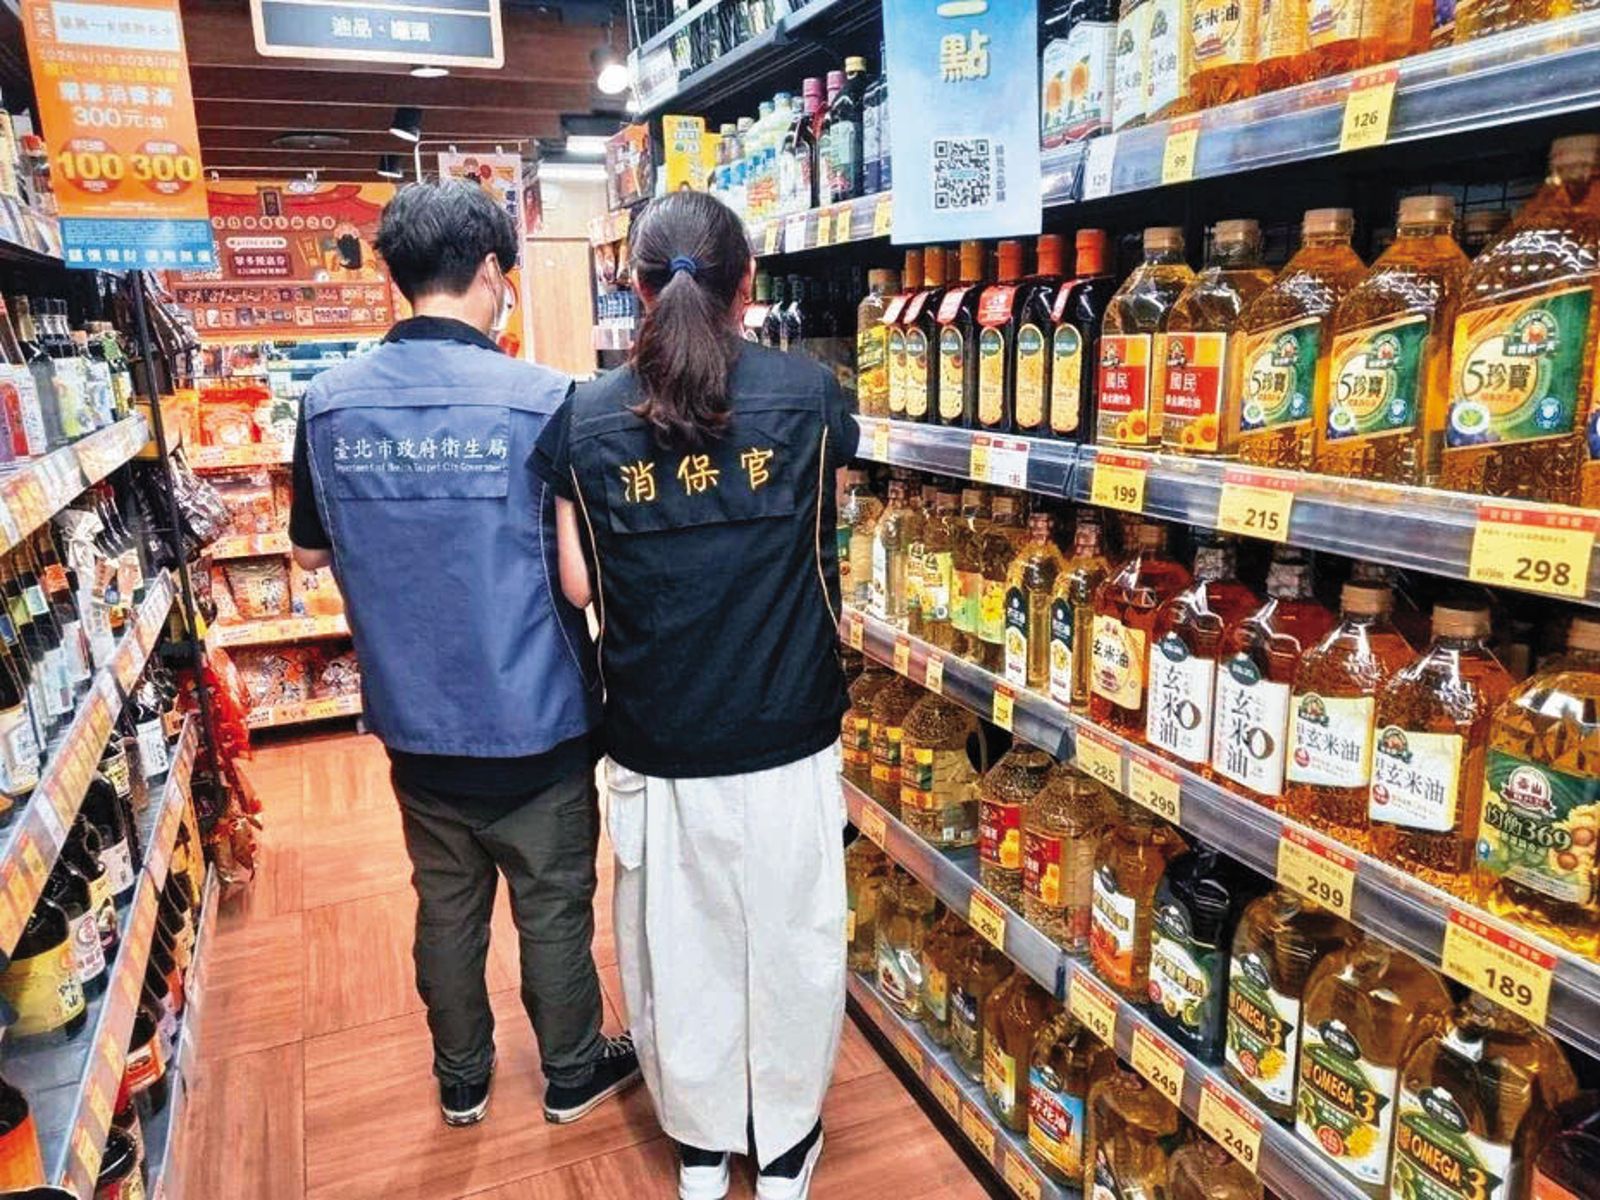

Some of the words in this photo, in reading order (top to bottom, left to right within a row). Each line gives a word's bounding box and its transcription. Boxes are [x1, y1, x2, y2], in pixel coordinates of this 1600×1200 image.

[1353, 111, 1378, 128] 126
[57, 152, 125, 180] 100
[130, 154, 199, 182] 300
[1105, 372, 1130, 391] 國民
[1169, 372, 1197, 392] 國民
[1337, 373, 1384, 402] 5珍寶
[1465, 360, 1532, 399] 5珍寶
[333, 437, 508, 461] 臺北市政府衛生局
[620, 448, 774, 503] 消保官
[1113, 486, 1138, 503] 199
[1244, 509, 1279, 531] 215
[1514, 557, 1571, 586] 298
[1094, 638, 1130, 670] 玄米油
[1160, 664, 1182, 748] 玄米油
[1227, 688, 1252, 779] 玄米油
[1306, 728, 1361, 763] 玄米油
[1386, 764, 1445, 805] 玄米油
[1150, 791, 1176, 816] 299
[1307, 876, 1344, 908] 299
[1485, 967, 1533, 1006] 189
[1236, 996, 1267, 1036] OMEGA
[1267, 1017, 1282, 1047] 3
[1153, 1066, 1177, 1096] 249
[1313, 1064, 1355, 1110] OMEGA
[1355, 1090, 1376, 1122] 3
[1224, 1128, 1254, 1162] 249
[1411, 1134, 1461, 1187] OMEGA
[1461, 1167, 1487, 1200] 3
